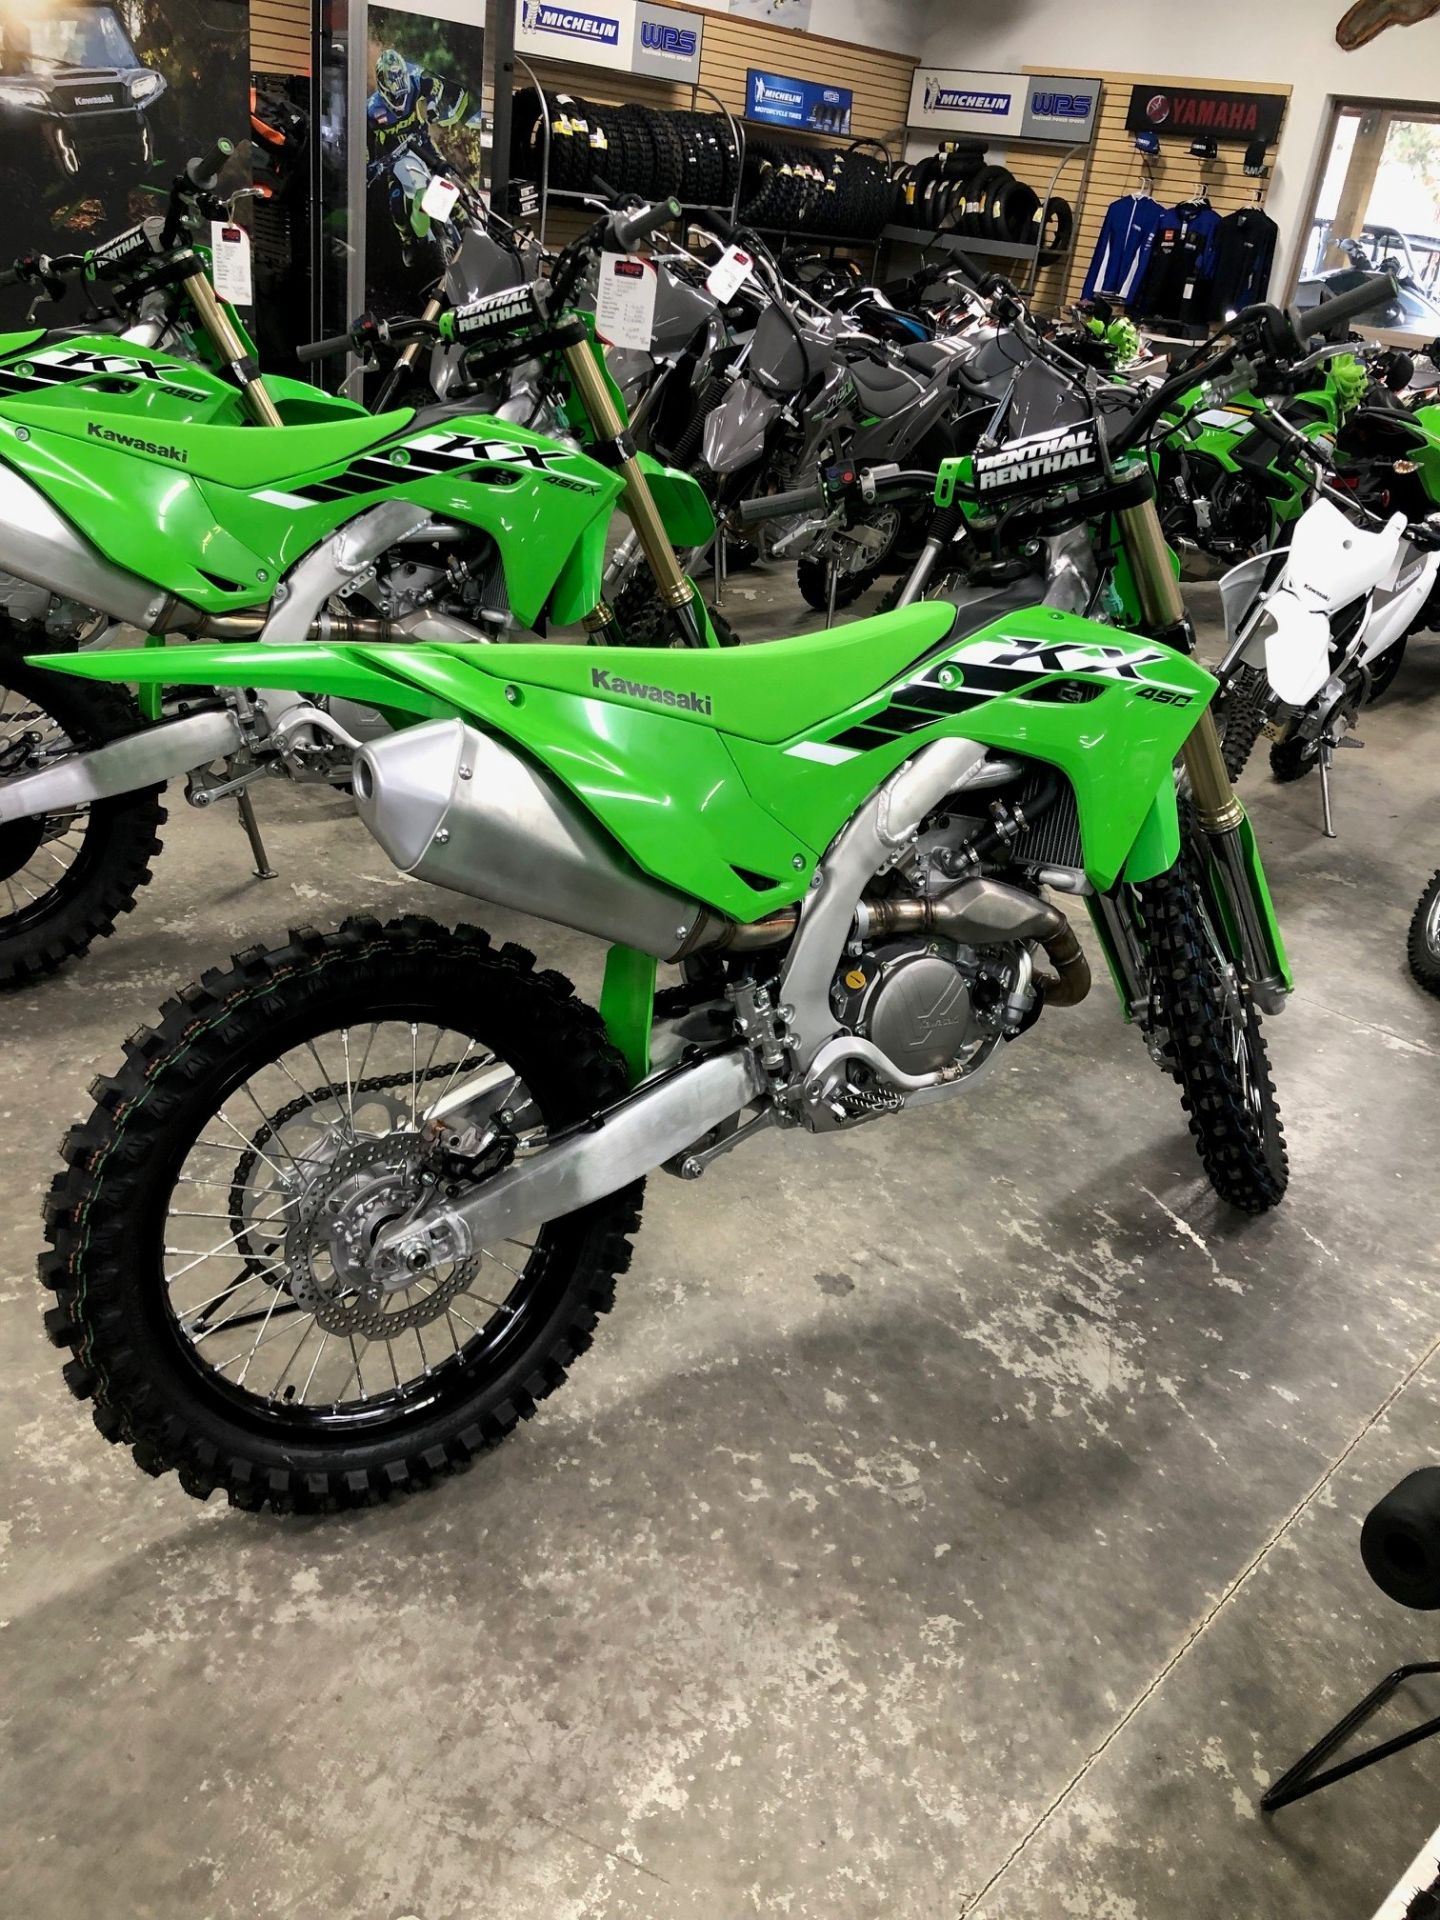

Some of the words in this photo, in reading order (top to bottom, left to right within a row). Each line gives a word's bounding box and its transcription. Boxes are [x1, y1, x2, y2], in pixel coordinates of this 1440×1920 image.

[542, 11, 617, 38] MICHELIN
[641, 21, 697, 57] WPS
[74, 94, 114, 106] Kawasaki
[764, 90, 802, 104] MICHELIN
[940, 93, 1008, 110] MICHELIN
[1031, 92, 1093, 118] WPS
[1173, 98, 1259, 131] YAMAHA
[459, 301, 533, 333] RENTHAL
[56, 350, 186, 382] KX
[157, 386, 209, 403] 450
[87, 422, 188, 464] Kawasaki
[434, 434, 573, 471] KX
[980, 447, 1096, 491] RENTHAL
[988, 637, 1170, 681] KX
[591, 667, 712, 716] Kawasaki
[1135, 687, 1196, 708] 450
